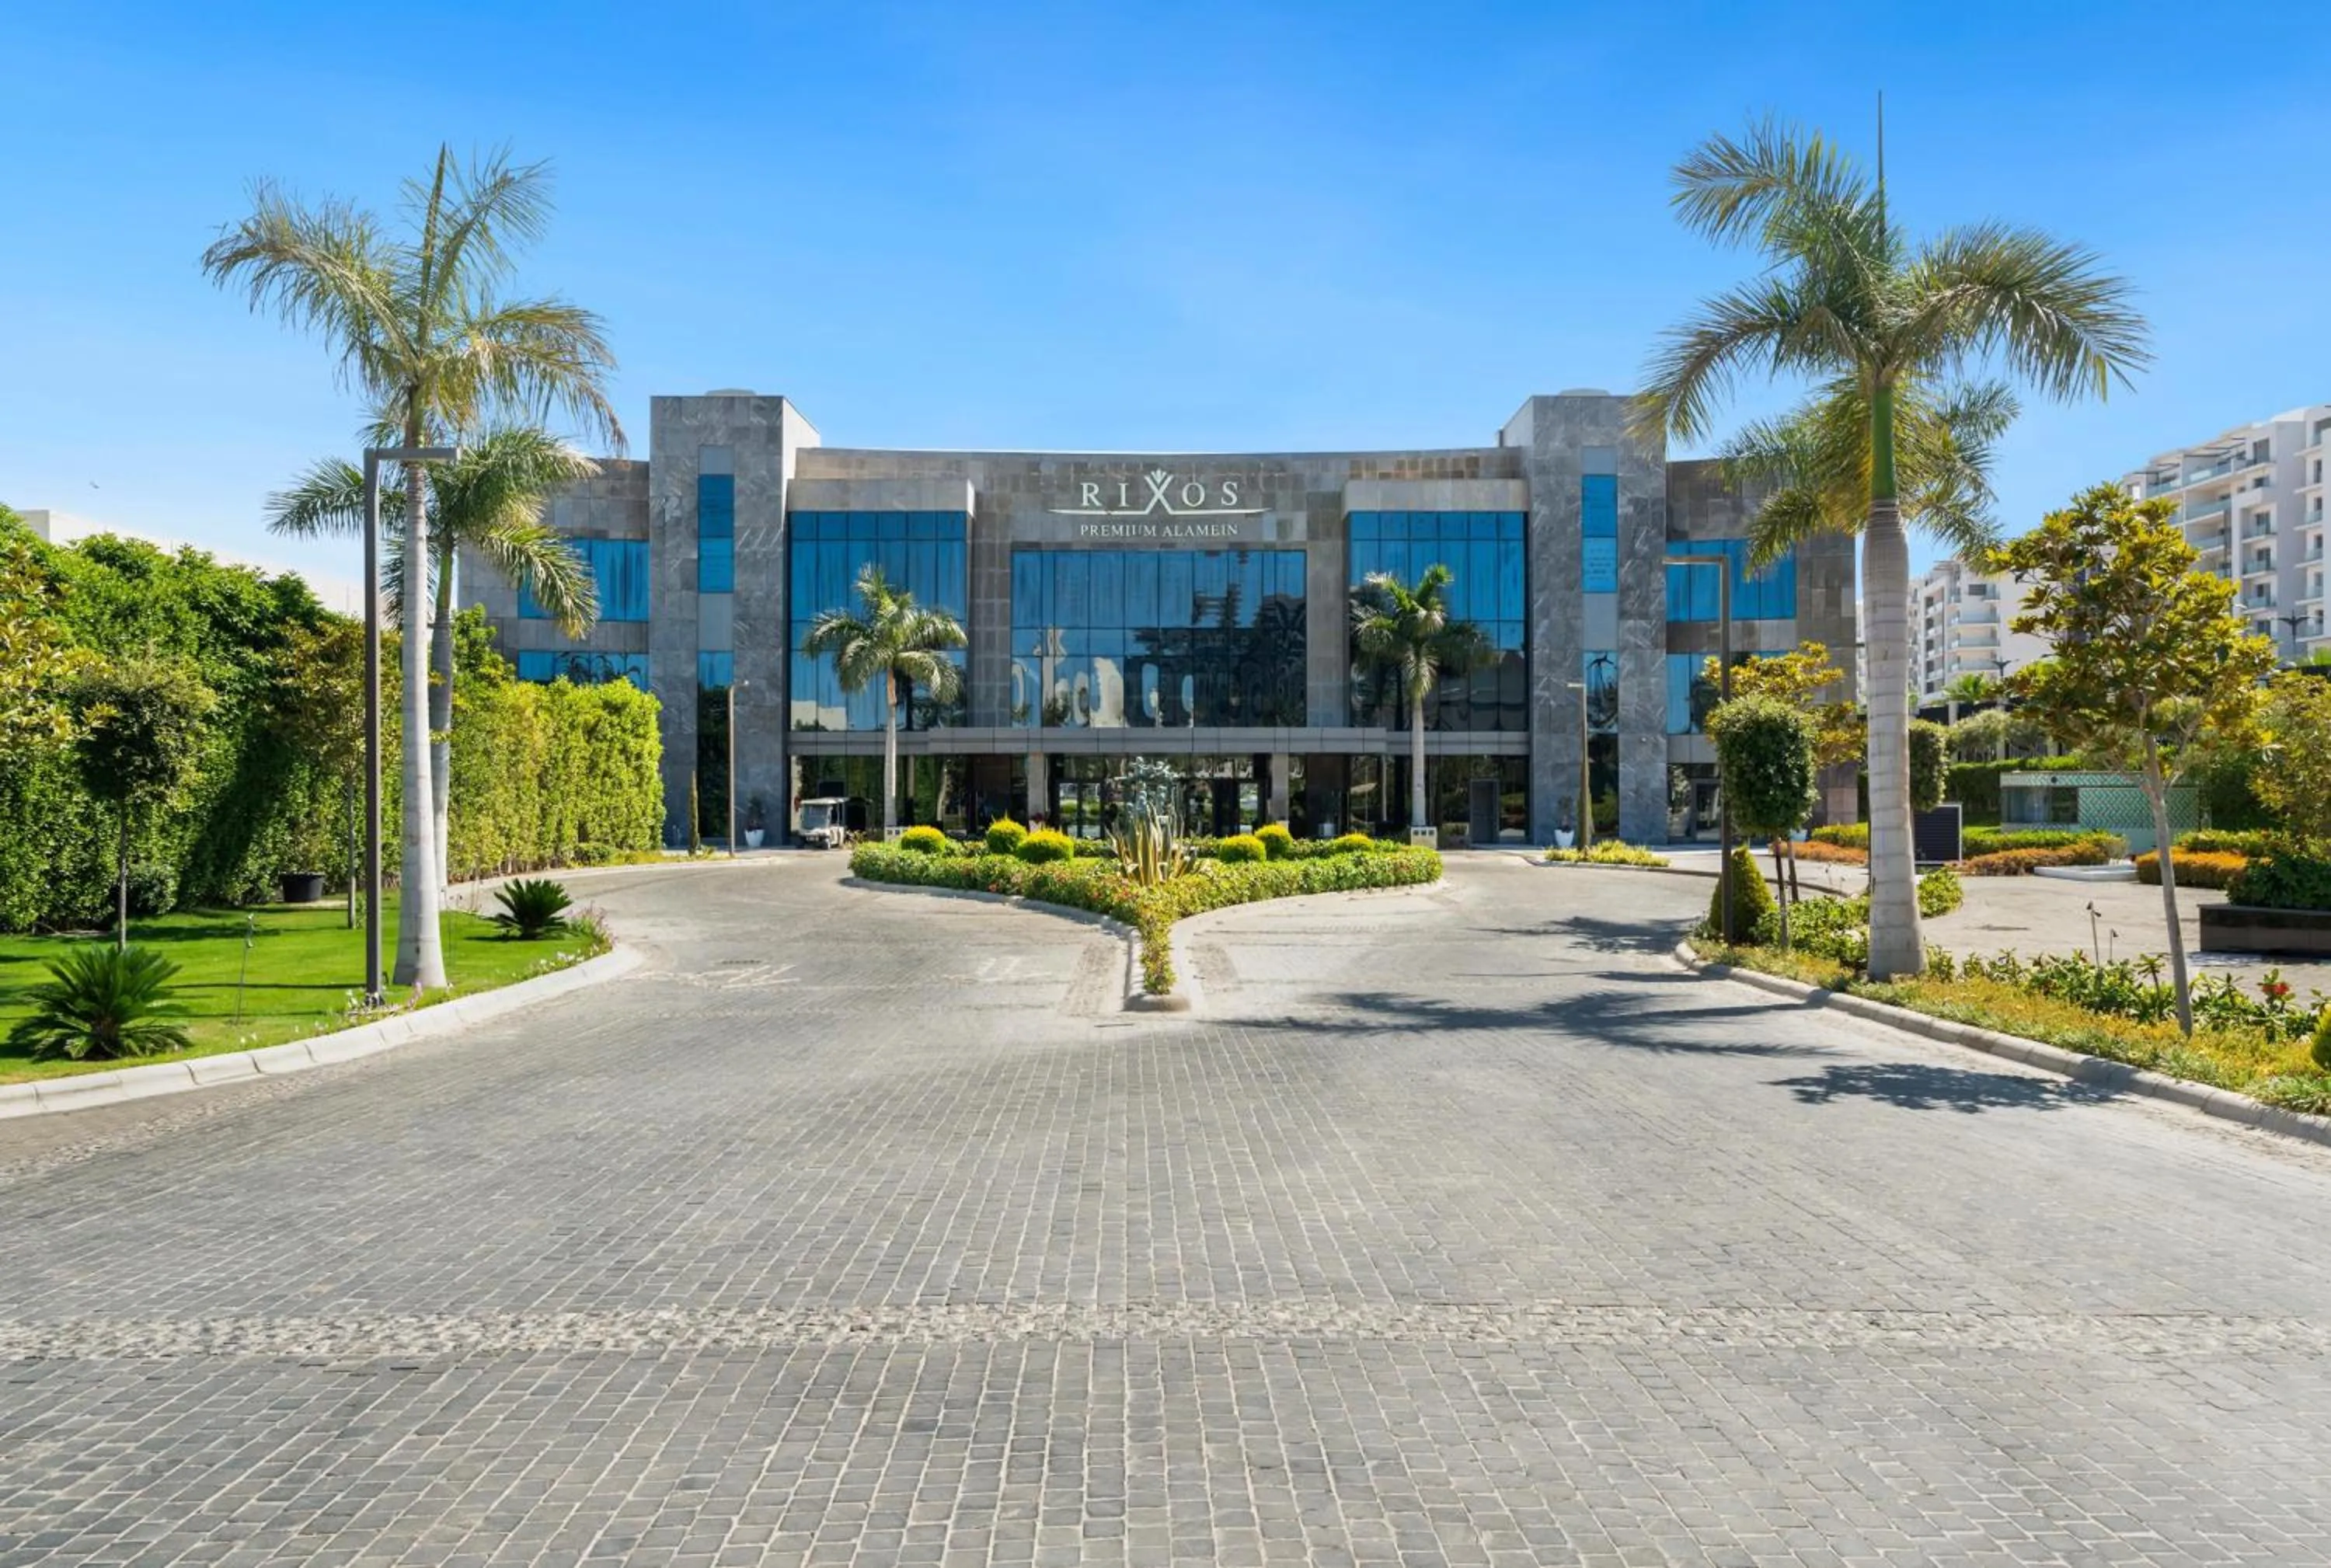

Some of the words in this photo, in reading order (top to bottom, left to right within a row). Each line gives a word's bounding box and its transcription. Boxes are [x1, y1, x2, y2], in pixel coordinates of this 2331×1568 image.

[1081, 472, 1239, 514] RIXOS
[1080, 524, 1157, 537] PREMIUM
[1162, 524, 1239, 536] ALAMEIN
